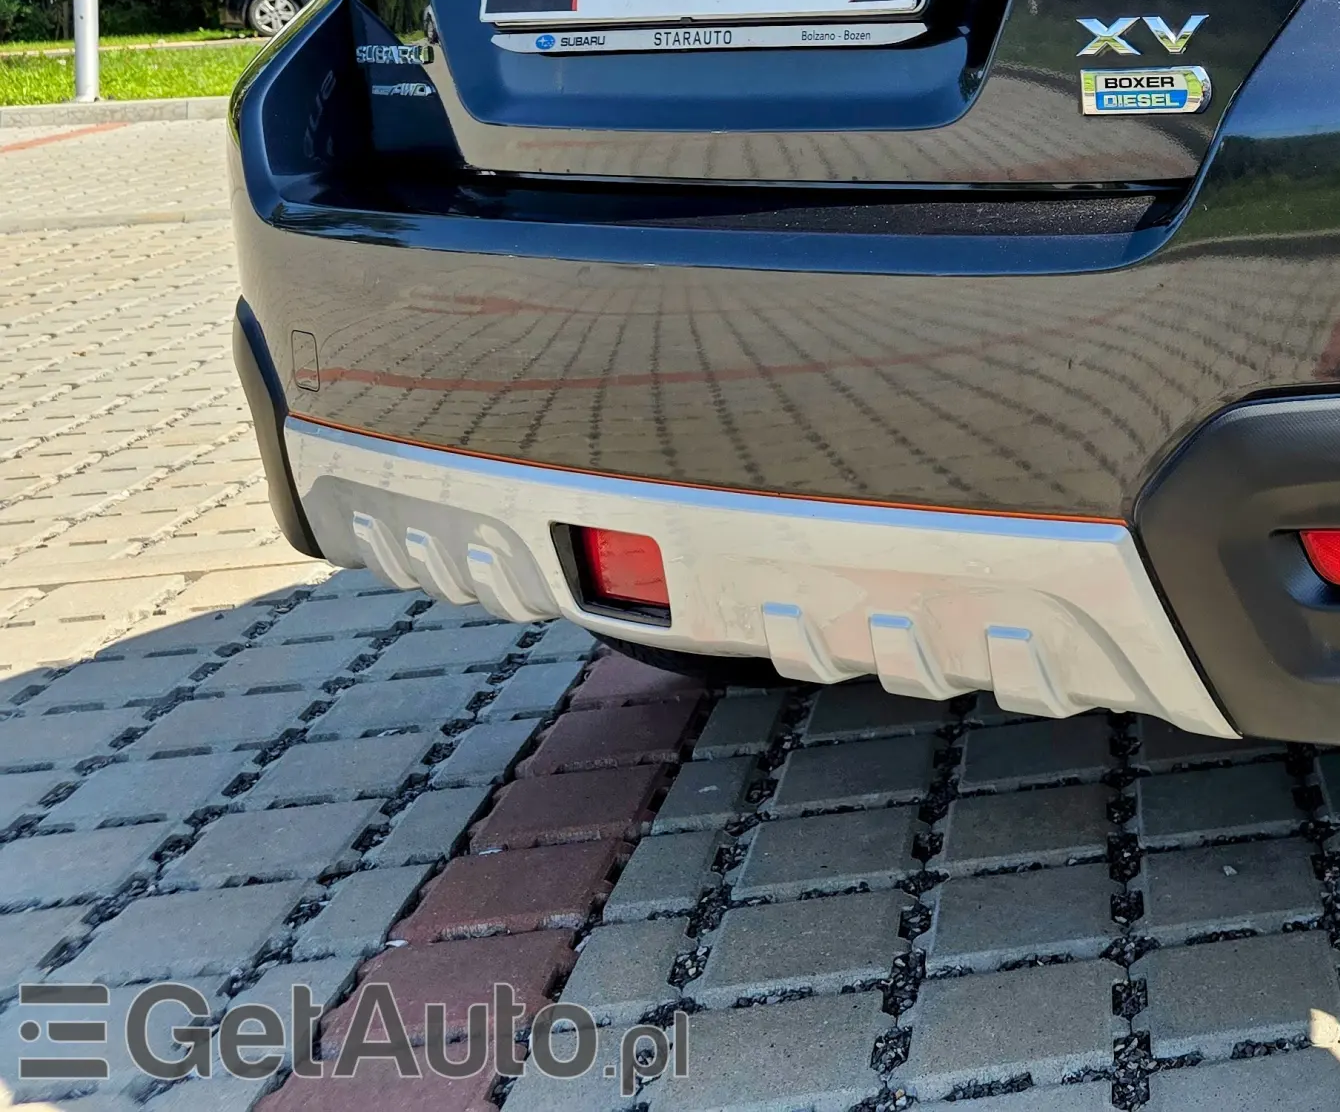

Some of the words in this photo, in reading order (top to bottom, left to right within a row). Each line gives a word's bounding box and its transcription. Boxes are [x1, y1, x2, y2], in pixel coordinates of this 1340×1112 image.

[560, 35, 606, 47] SUBARU
[654, 30, 732, 45] STARAUTO
[801, 29, 836, 41] Bolzano
[843, 29, 871, 41] Bozen
[1076, 14, 1210, 57] XV
[1104, 76, 1175, 89] BOXER
[1103, 93, 1180, 108] DIESEL
